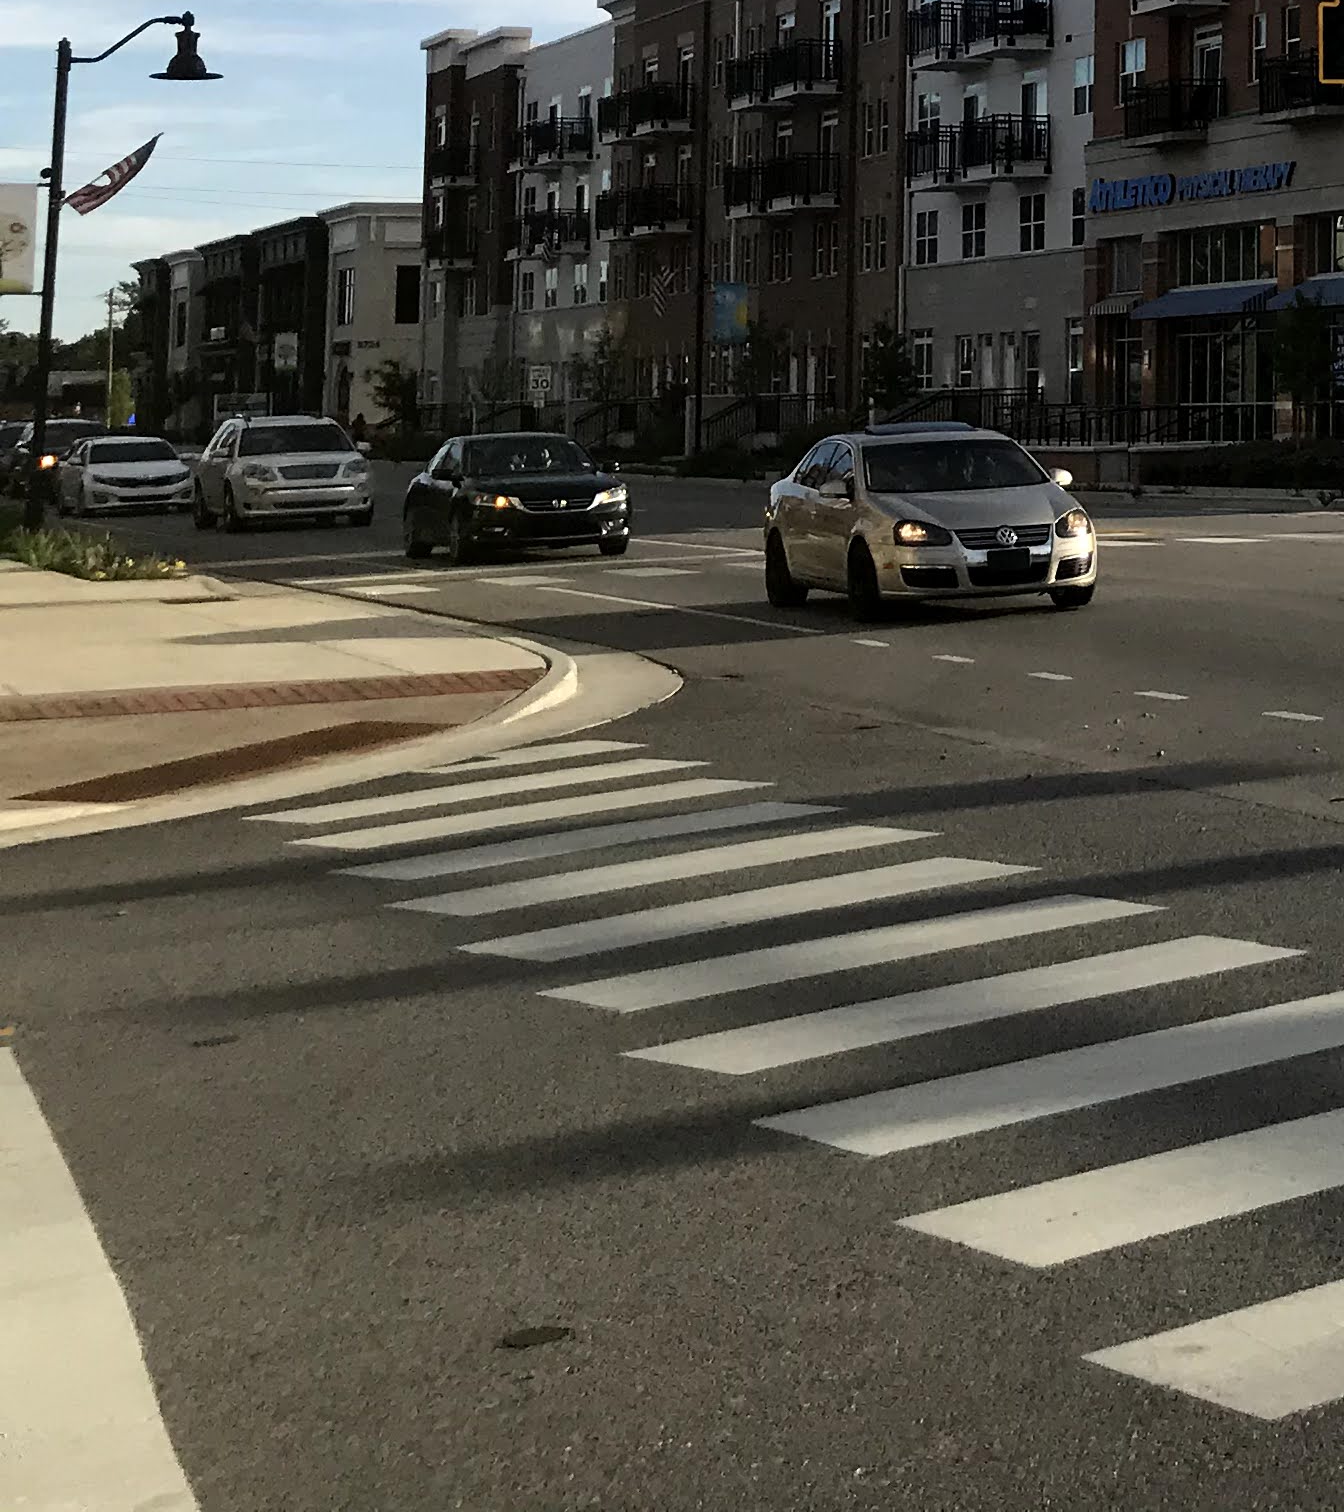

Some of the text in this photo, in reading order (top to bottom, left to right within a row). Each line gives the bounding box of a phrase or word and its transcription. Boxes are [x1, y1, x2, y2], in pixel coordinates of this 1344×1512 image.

[1088, 161, 1296, 213] ATHLETICO PHYSICAL THERAPY
[532, 379, 549, 389] 30
